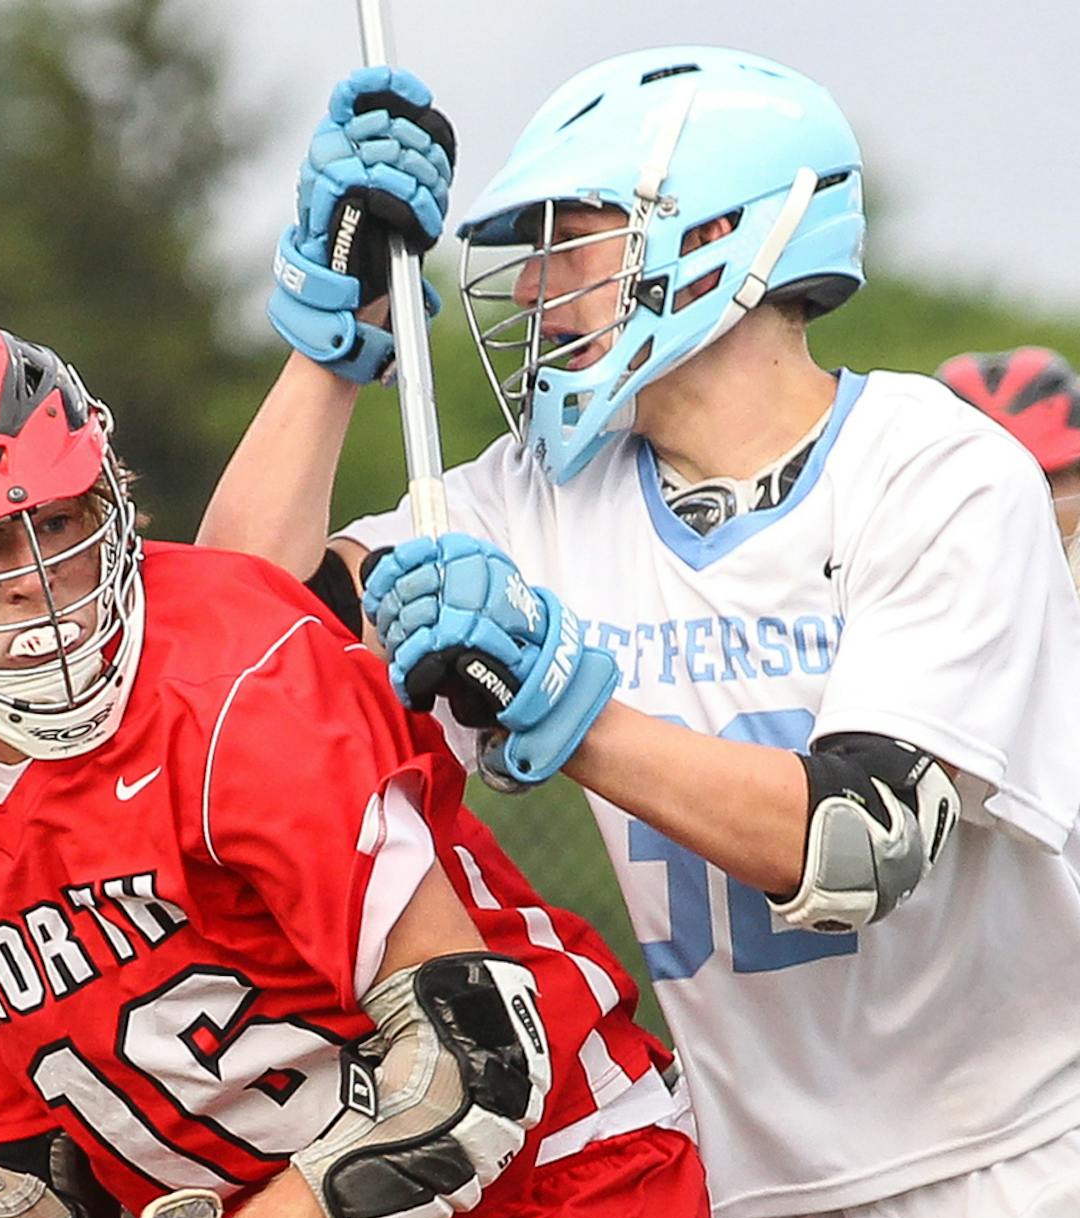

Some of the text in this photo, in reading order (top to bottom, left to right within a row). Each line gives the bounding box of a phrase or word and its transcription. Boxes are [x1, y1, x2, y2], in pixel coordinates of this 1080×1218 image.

[331, 204, 361, 275] BRINE
[576, 614, 846, 690] EFFERSO
[27, 964, 348, 1197] 16
